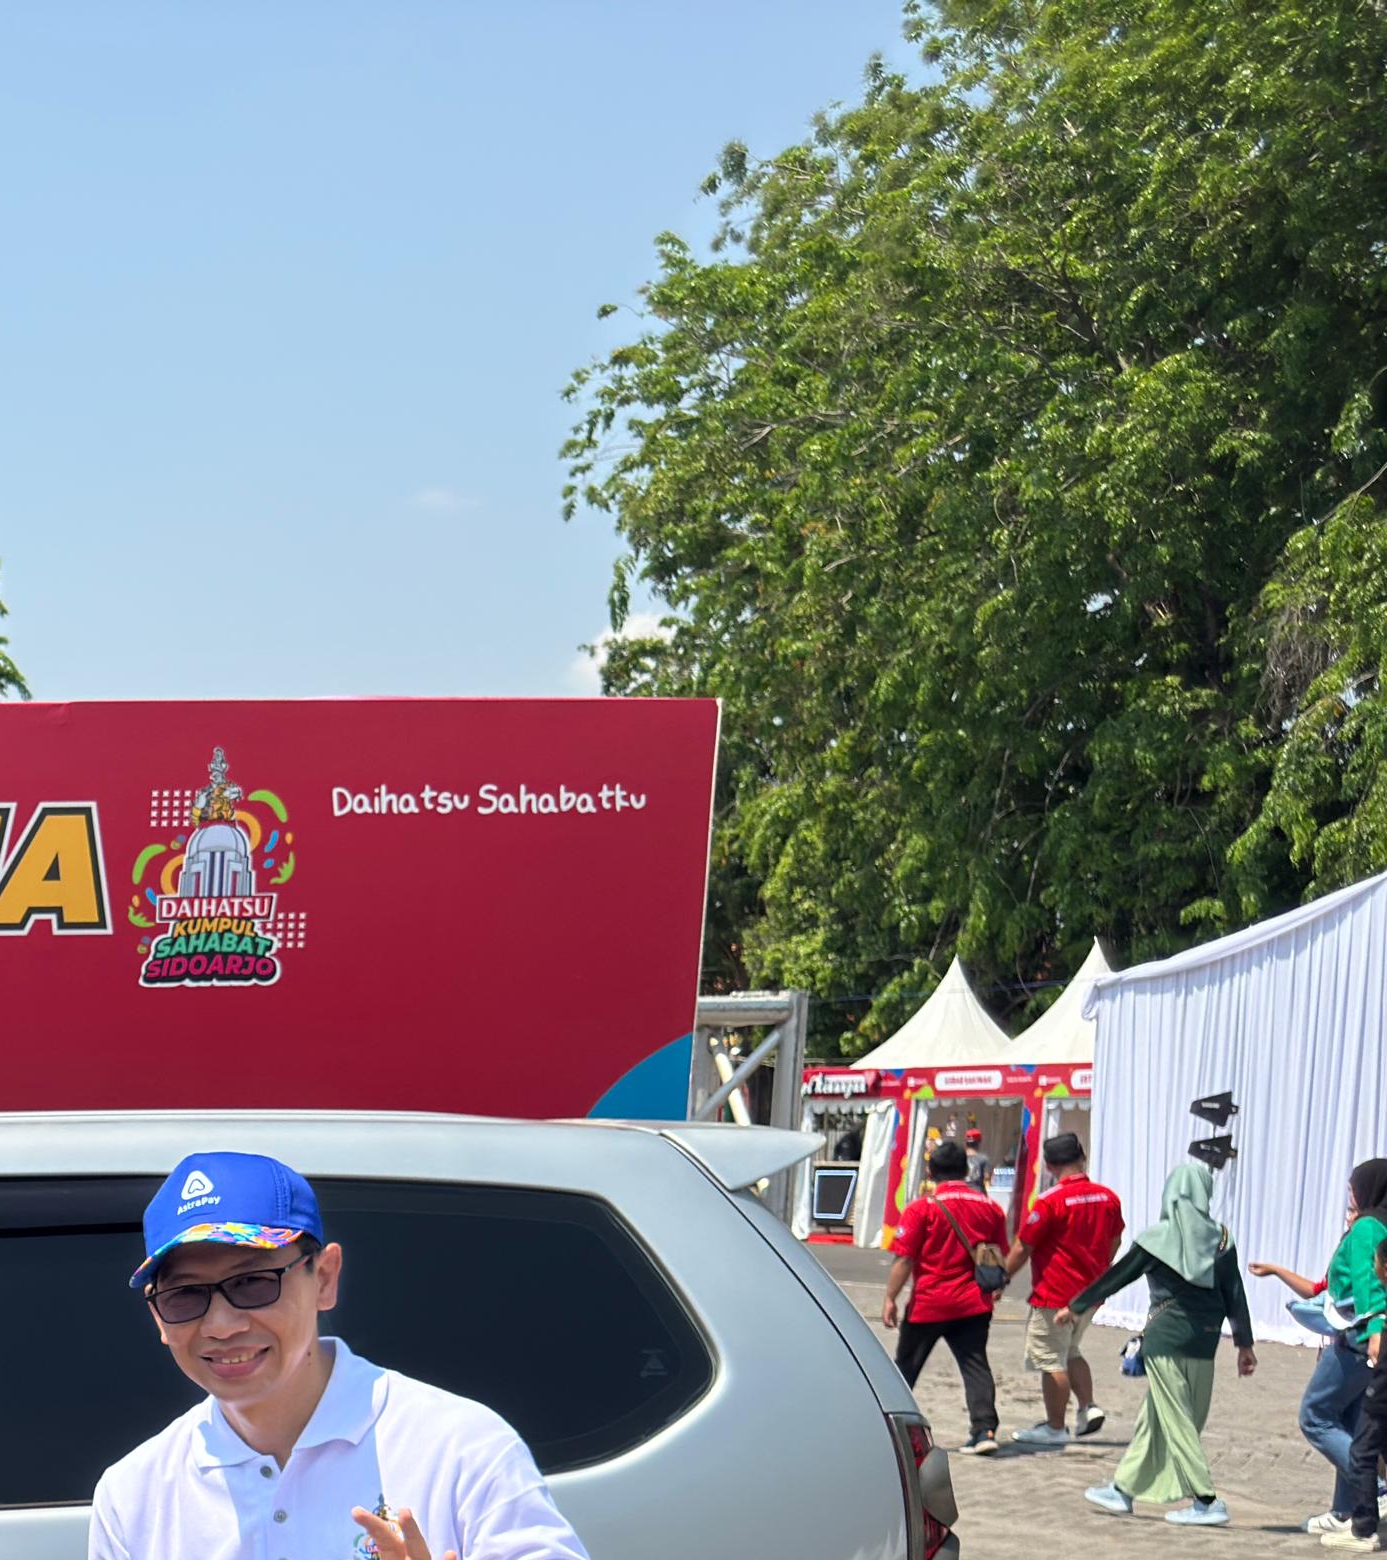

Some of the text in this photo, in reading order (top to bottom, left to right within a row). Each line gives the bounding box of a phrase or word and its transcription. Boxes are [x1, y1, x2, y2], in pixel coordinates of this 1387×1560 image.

[331, 783, 647, 817] Daihatsu Sahabatku
[161, 897, 270, 918] DAIHATSU
[173, 917, 257, 938] KUMPUL
[155, 931, 272, 958] SAHABAT
[146, 954, 275, 977] SIDOARJO
[176, 1195, 221, 1215] AstraPay
